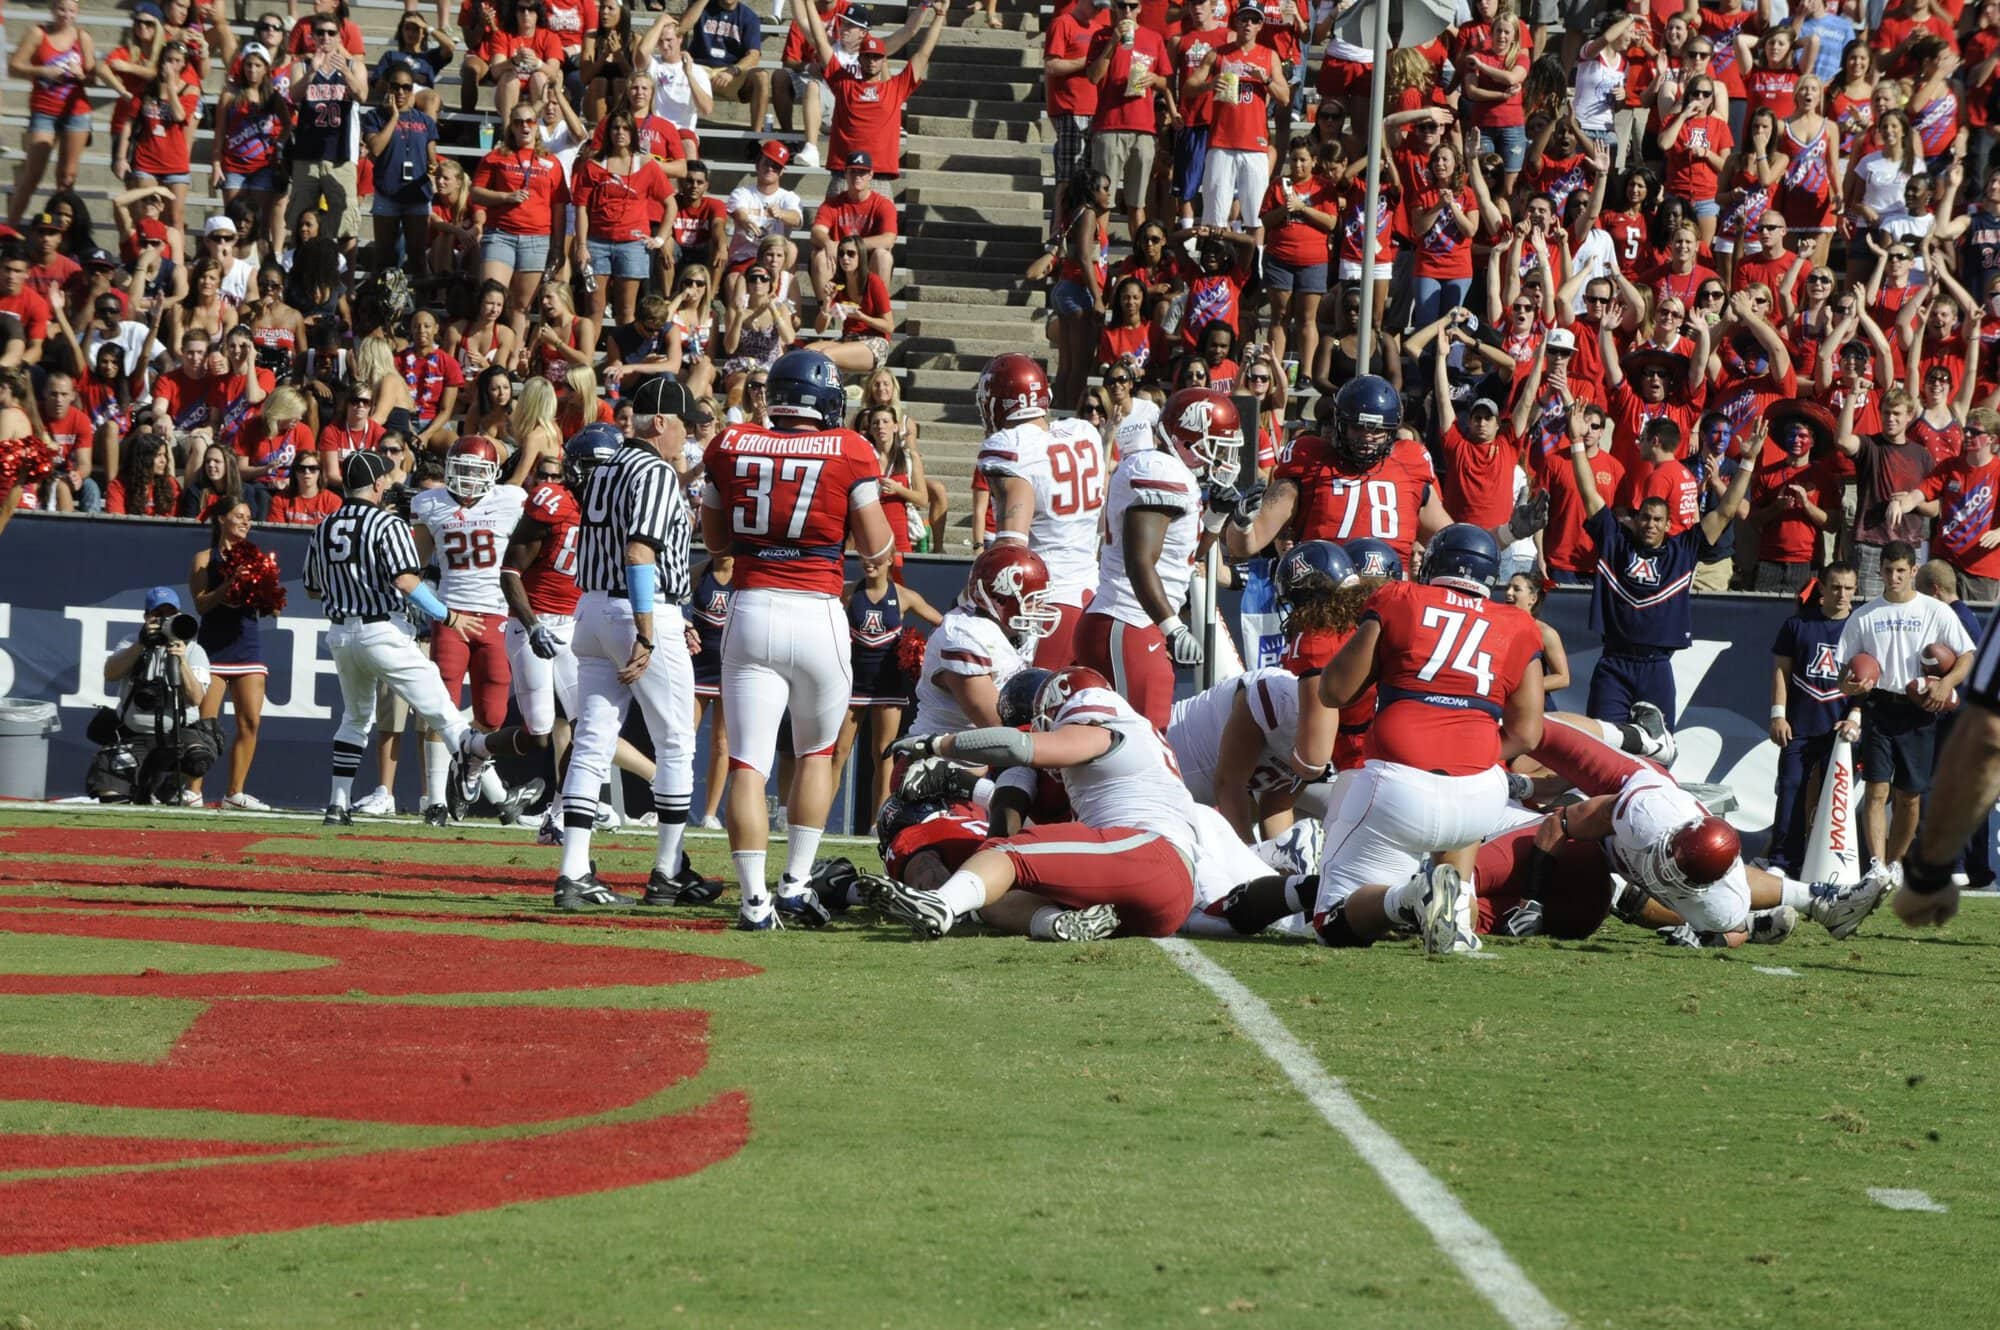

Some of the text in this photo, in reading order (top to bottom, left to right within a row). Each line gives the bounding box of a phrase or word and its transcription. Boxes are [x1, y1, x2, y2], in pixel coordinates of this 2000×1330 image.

[306, 83, 346, 101] RIZON
[314, 103, 342, 127] 20
[1624, 225, 1641, 259] 5
[1018, 391, 1038, 408] 92
[735, 434, 842, 456] GRONKOWSKI
[1047, 439, 1103, 515] 92
[532, 486, 563, 515] 84
[587, 465, 619, 522] U
[733, 455, 825, 539] 37
[1332, 478, 1399, 539] 78
[478, 519, 497, 528] STATE
[329, 519, 357, 561] S
[443, 529, 497, 570] 28
[757, 549, 800, 557] ARIZONA
[1362, 552, 1386, 577] A
[1625, 553, 1661, 586] A
[709, 591, 729, 614] A
[860, 610, 886, 634] A
[1417, 606, 1495, 696] 74
[1806, 642, 1842, 680] A
[1423, 695, 1469, 708] ARIZONA
[1829, 760, 1849, 851] ARIZONA
